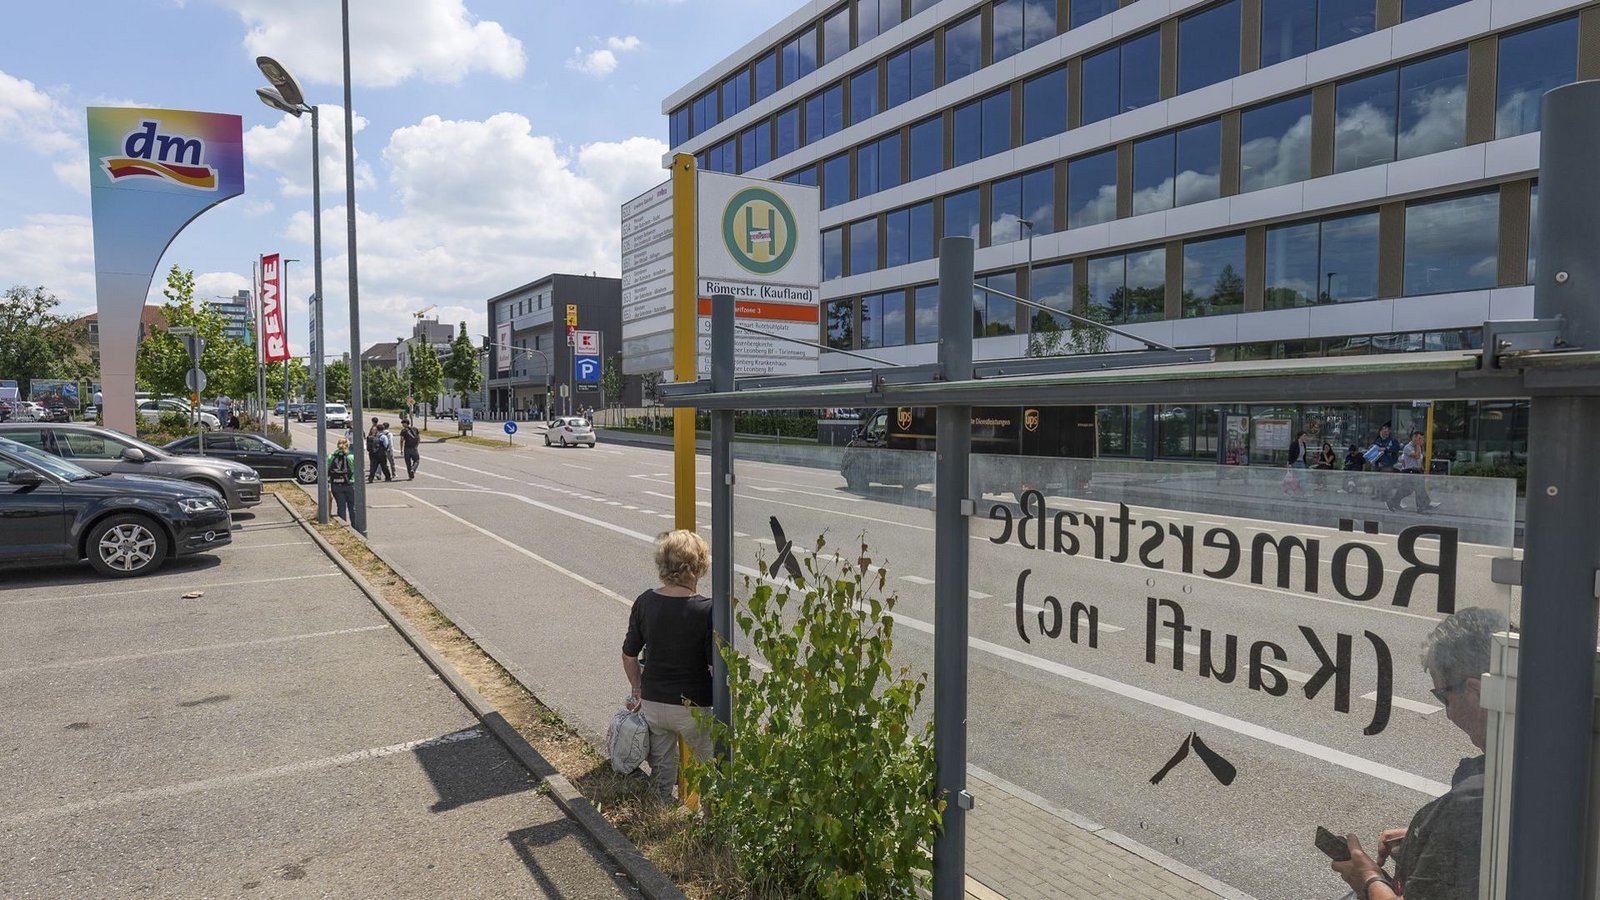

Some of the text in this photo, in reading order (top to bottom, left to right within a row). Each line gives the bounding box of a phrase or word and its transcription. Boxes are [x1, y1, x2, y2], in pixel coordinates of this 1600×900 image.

[125, 121, 201, 165] dm
[746, 206, 775, 255] H
[264, 260, 285, 357] REWE
[706, 281, 813, 302] Römerstr. (Kaufland)
